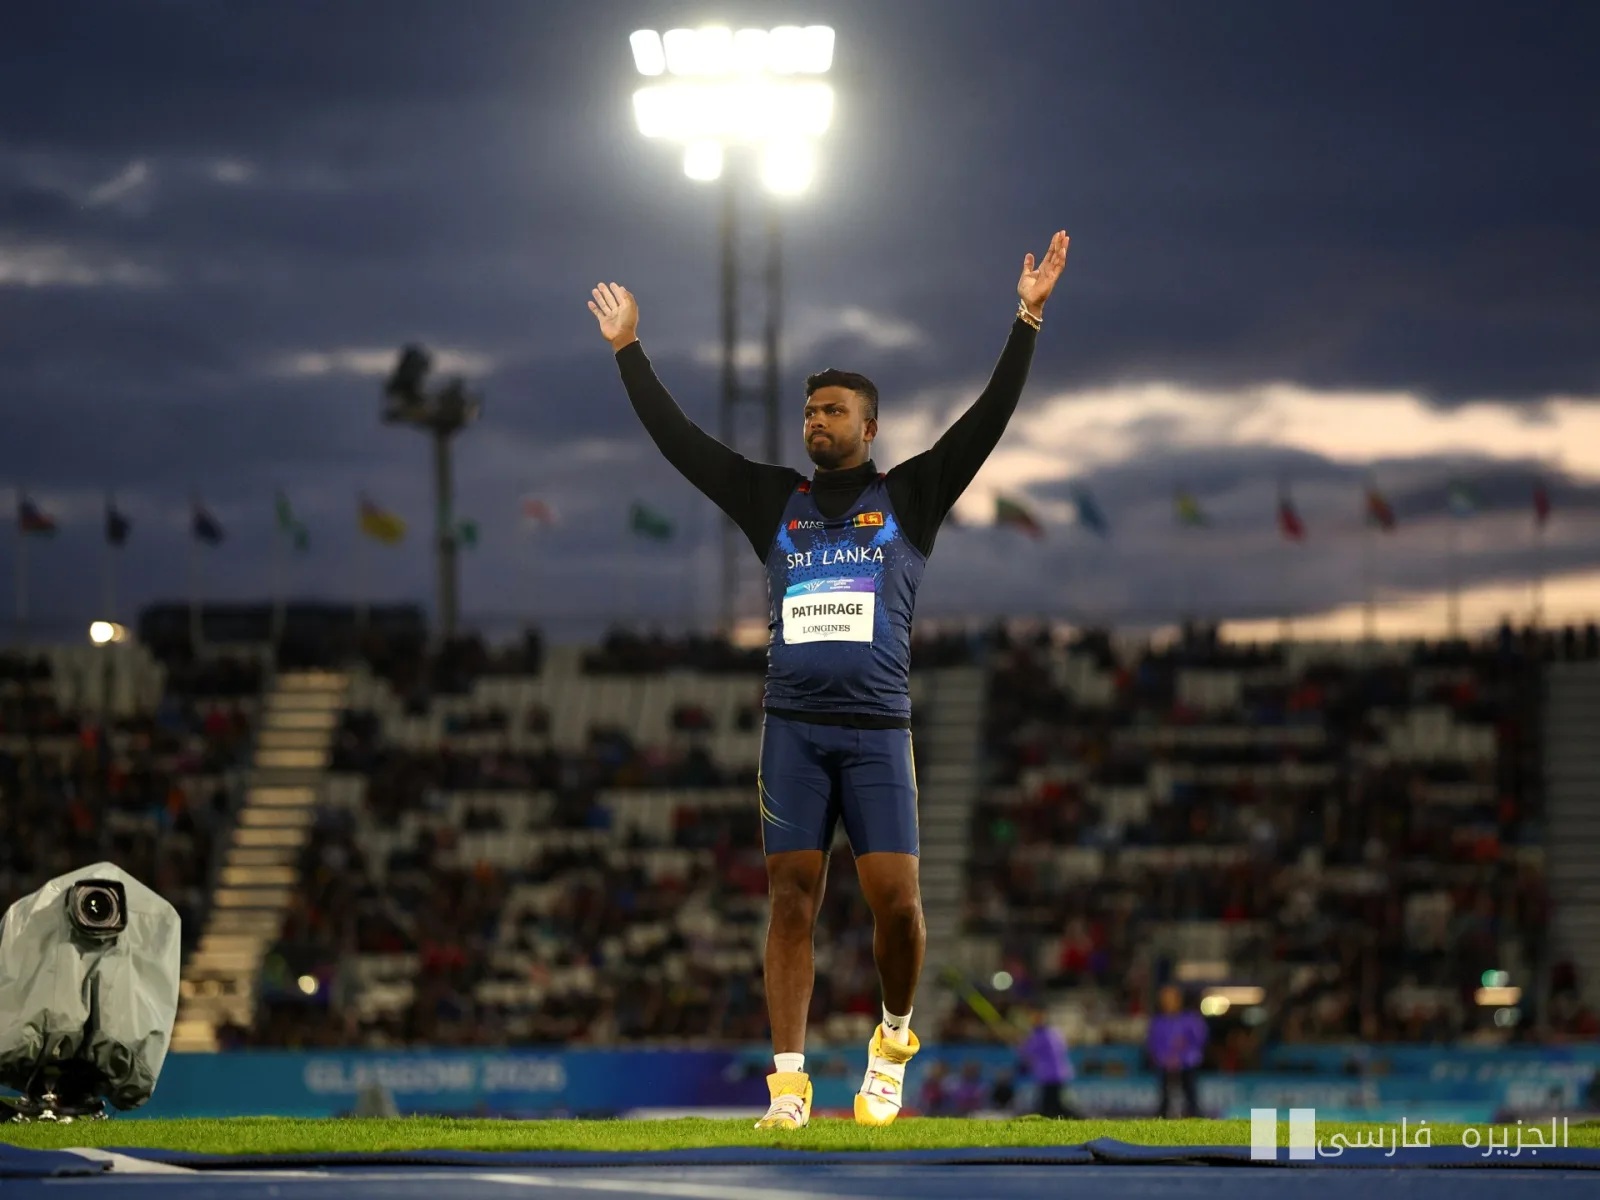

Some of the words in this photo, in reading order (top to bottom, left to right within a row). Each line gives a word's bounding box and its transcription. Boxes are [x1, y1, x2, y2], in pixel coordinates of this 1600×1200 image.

[798, 520, 824, 529] MAS
[786, 551, 812, 569] SRI
[822, 546, 885, 565] LANKA
[791, 603, 863, 619] PATHIRAGE
[802, 624, 851, 634] LONGINES
